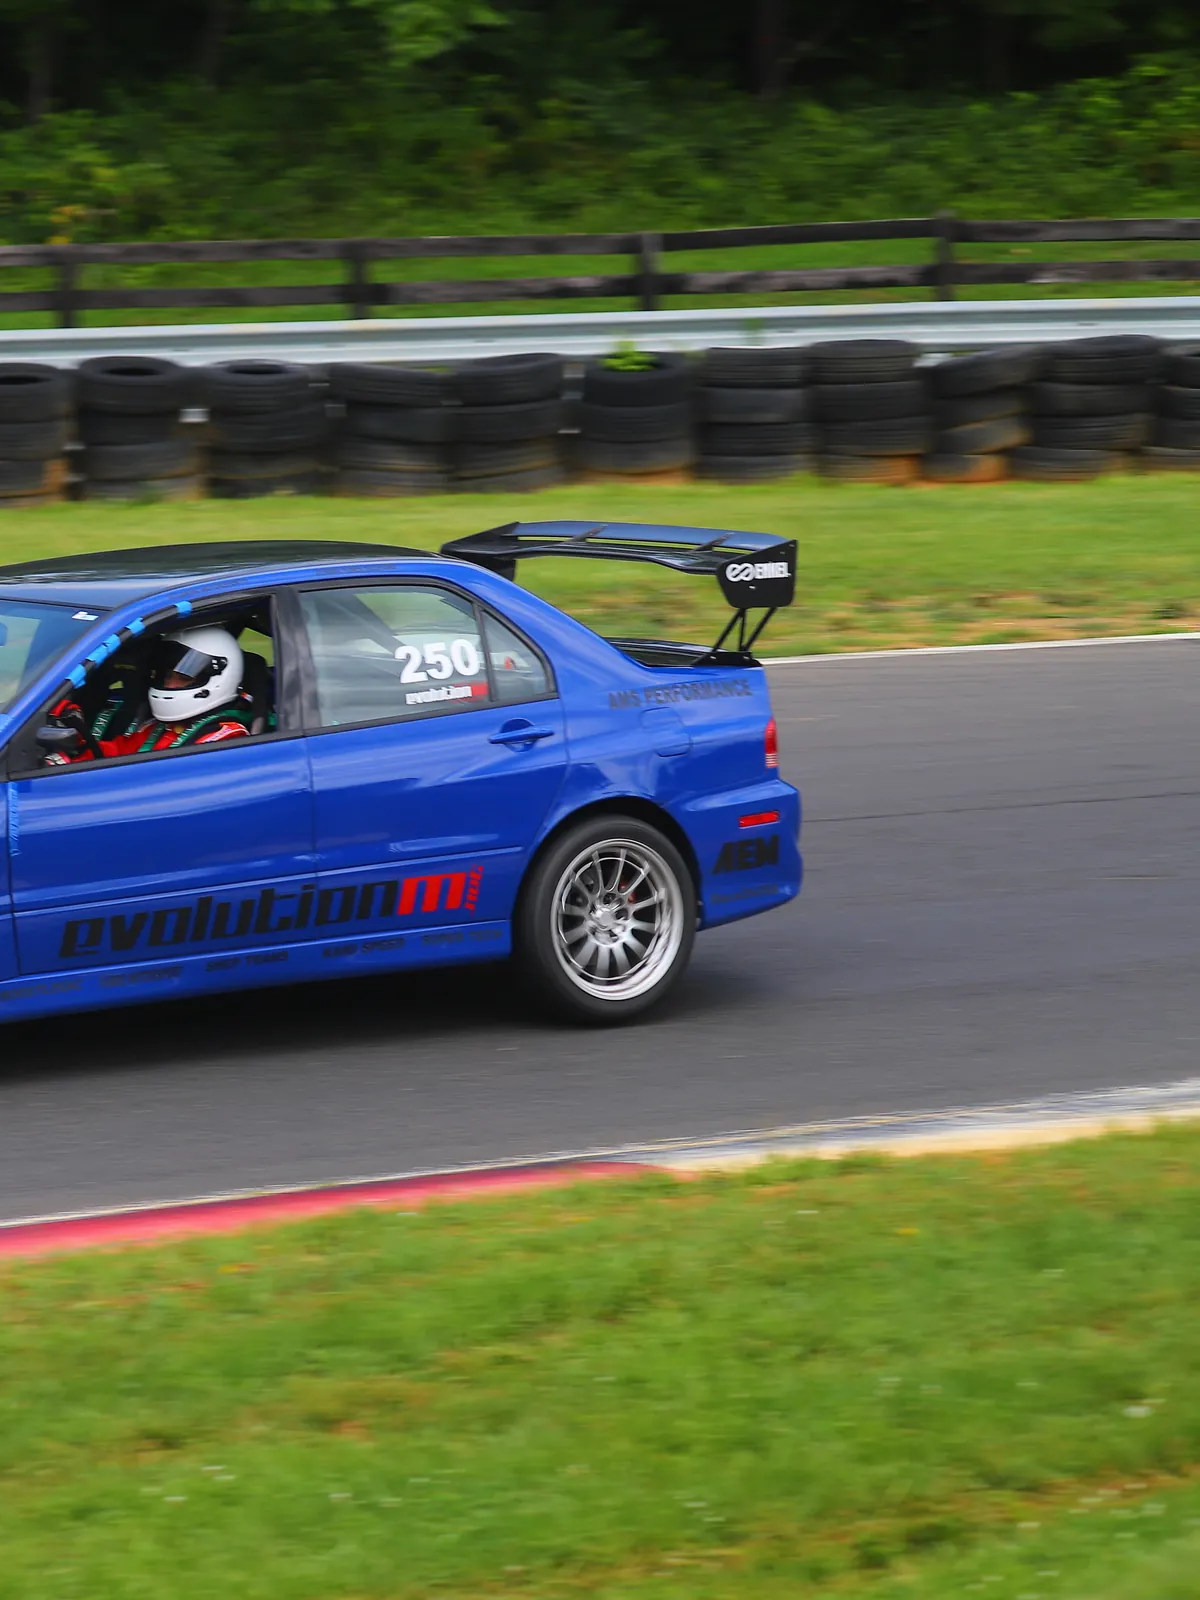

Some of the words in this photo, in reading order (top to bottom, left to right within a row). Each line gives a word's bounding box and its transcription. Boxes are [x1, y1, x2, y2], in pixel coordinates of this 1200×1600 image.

[394, 638, 481, 684] 250
[608, 688, 642, 710] AMS
[643, 679, 754, 705] PERFORMANCE
[711, 834, 781, 875] AEM
